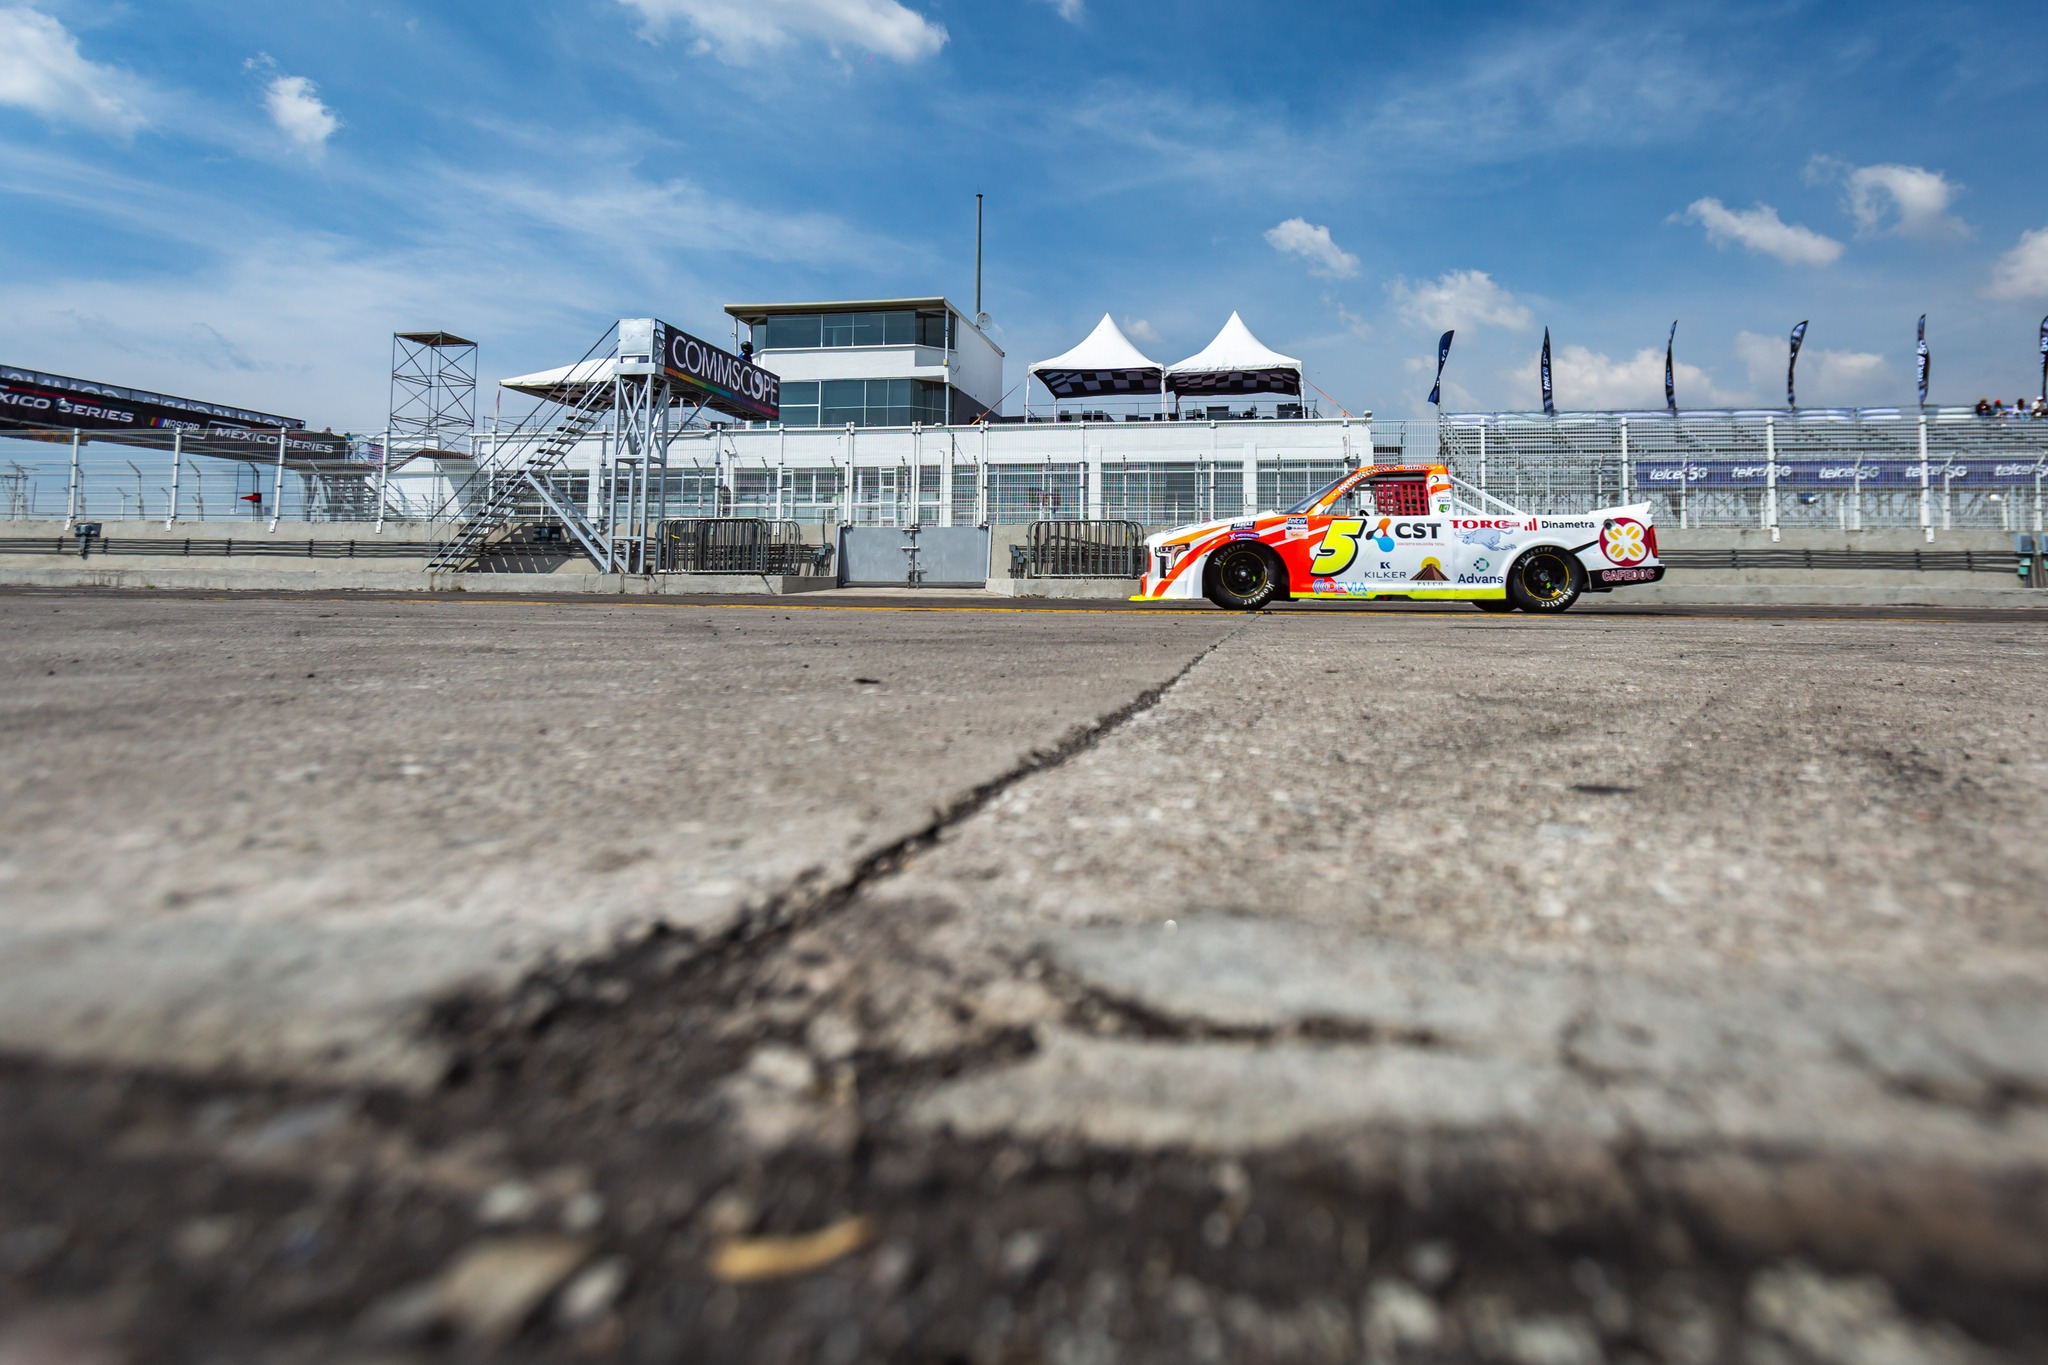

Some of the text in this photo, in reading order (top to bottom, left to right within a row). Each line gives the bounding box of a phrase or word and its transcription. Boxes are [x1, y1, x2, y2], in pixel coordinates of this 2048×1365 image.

[672, 335, 778, 406] COMMSCOPE
[163, 418, 200, 433] NASCAR
[284, 439, 334, 453] SERIES
[1688, 466, 1708, 481] 5G
[1395, 523, 1441, 539] CST
[1541, 521, 1595, 529] Dinametra
[1310, 519, 1368, 577] 5
[1364, 571, 1407, 579] KILKER
[1457, 573, 1504, 584] Advans
[1602, 569, 1655, 581] CAFEDOC
